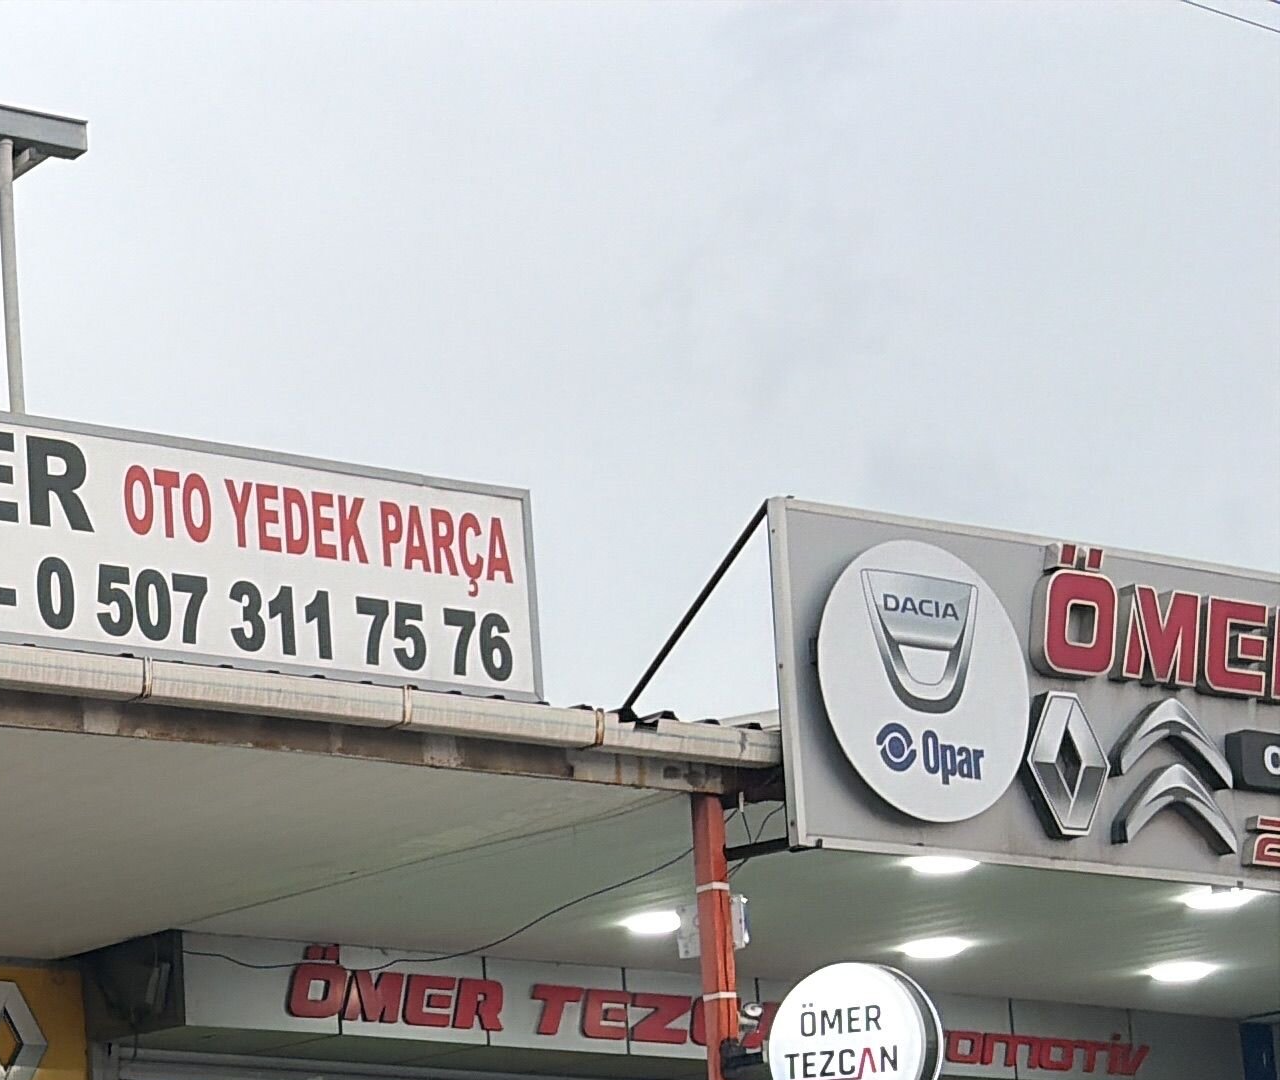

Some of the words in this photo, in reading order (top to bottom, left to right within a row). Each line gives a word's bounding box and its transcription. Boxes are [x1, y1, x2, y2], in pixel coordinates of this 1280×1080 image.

[124, 464, 210, 543] OTO
[225, 479, 367, 565] YEDEK
[381, 500, 512, 596] PARÇA
[37, 557, 74, 630] 0
[97, 567, 208, 642] 507
[230, 580, 333, 661] 311
[356, 598, 426, 673] 75
[443, 607, 512, 682] 76
[882, 592, 960, 622] DACIA
[1044, 544, 1280, 699] ÖME
[921, 729, 985, 785] Opar
[284, 944, 506, 1033] ÖMER
[800, 1003, 882, 1038] ÖMER
[784, 1044, 898, 1080] TEZCAN
